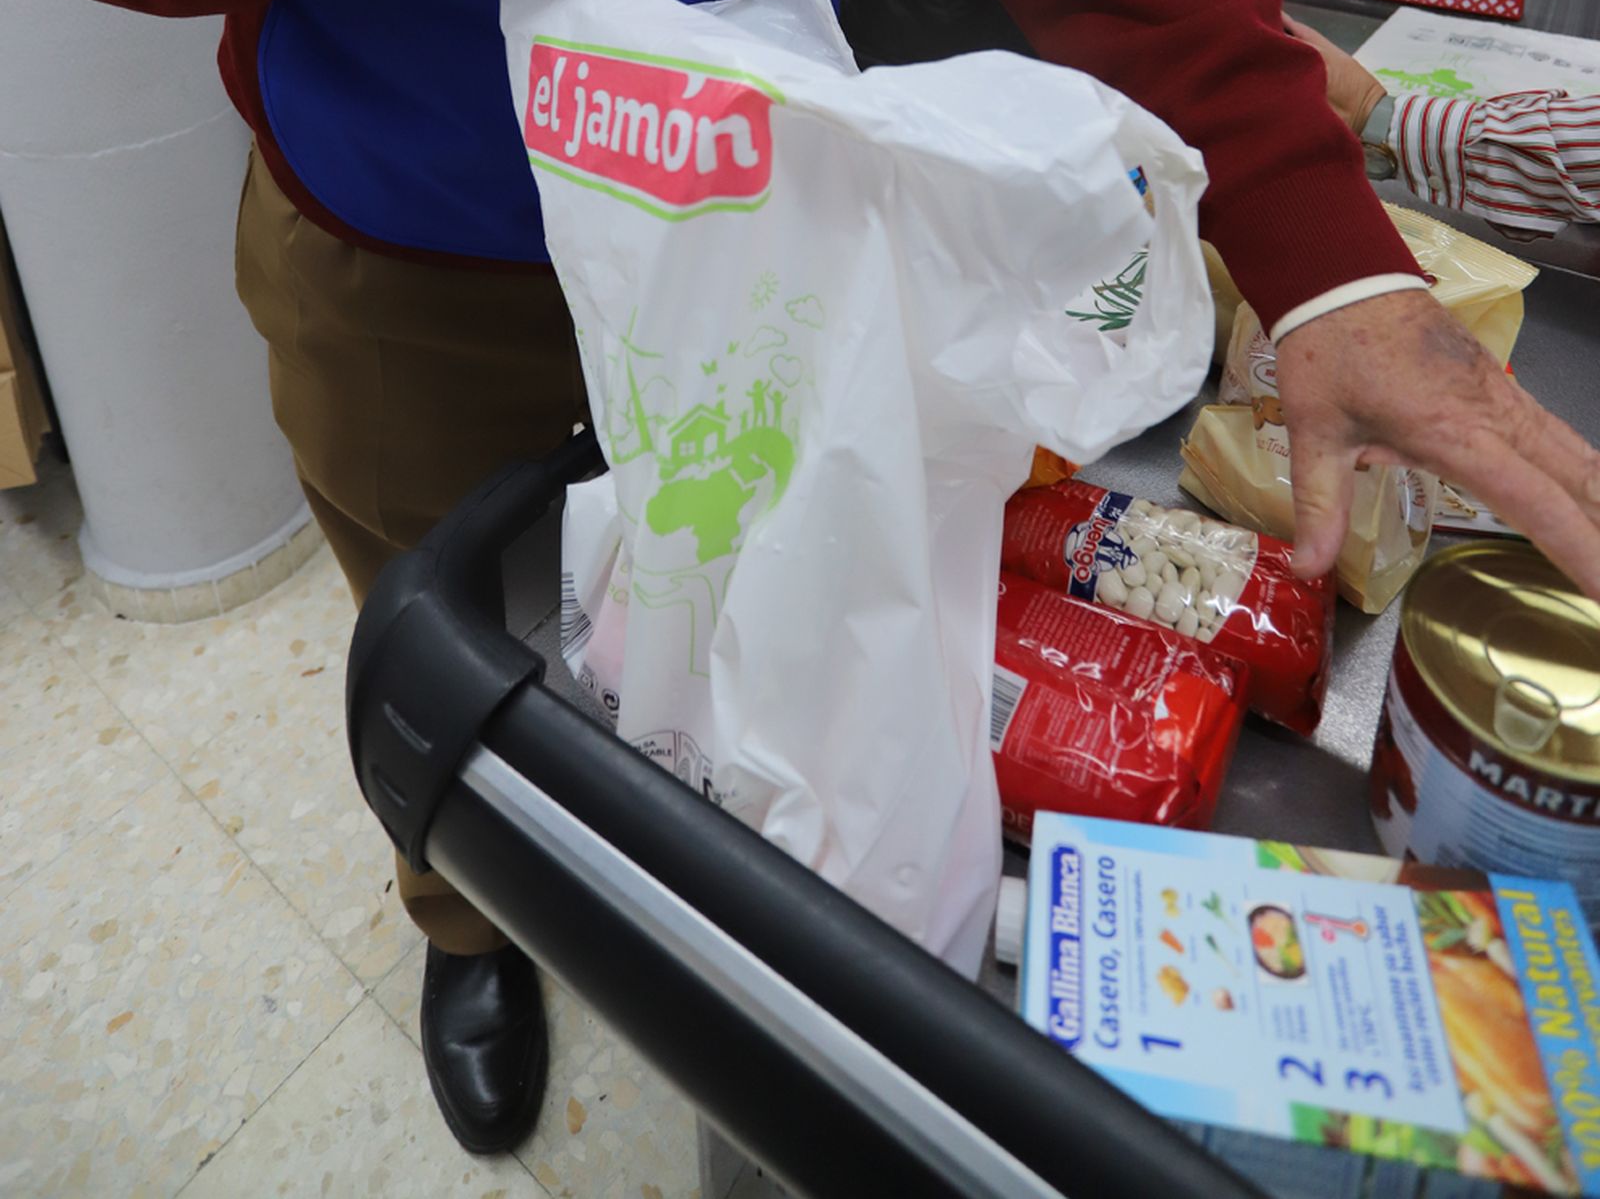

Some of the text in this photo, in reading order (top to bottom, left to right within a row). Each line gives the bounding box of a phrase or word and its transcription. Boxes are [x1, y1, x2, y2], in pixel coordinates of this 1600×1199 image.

[533, 56, 760, 175] el jamón
[1073, 517, 1115, 582] luengo
[1051, 852, 1081, 1041] Gallina Blanca
[1093, 856, 1121, 1050] Casero, Casero
[1498, 887, 1580, 1039] Natural
[1140, 1033, 1182, 1052] 1
[1279, 1056, 1325, 1087] 2
[1345, 1068, 1394, 1100] 3
